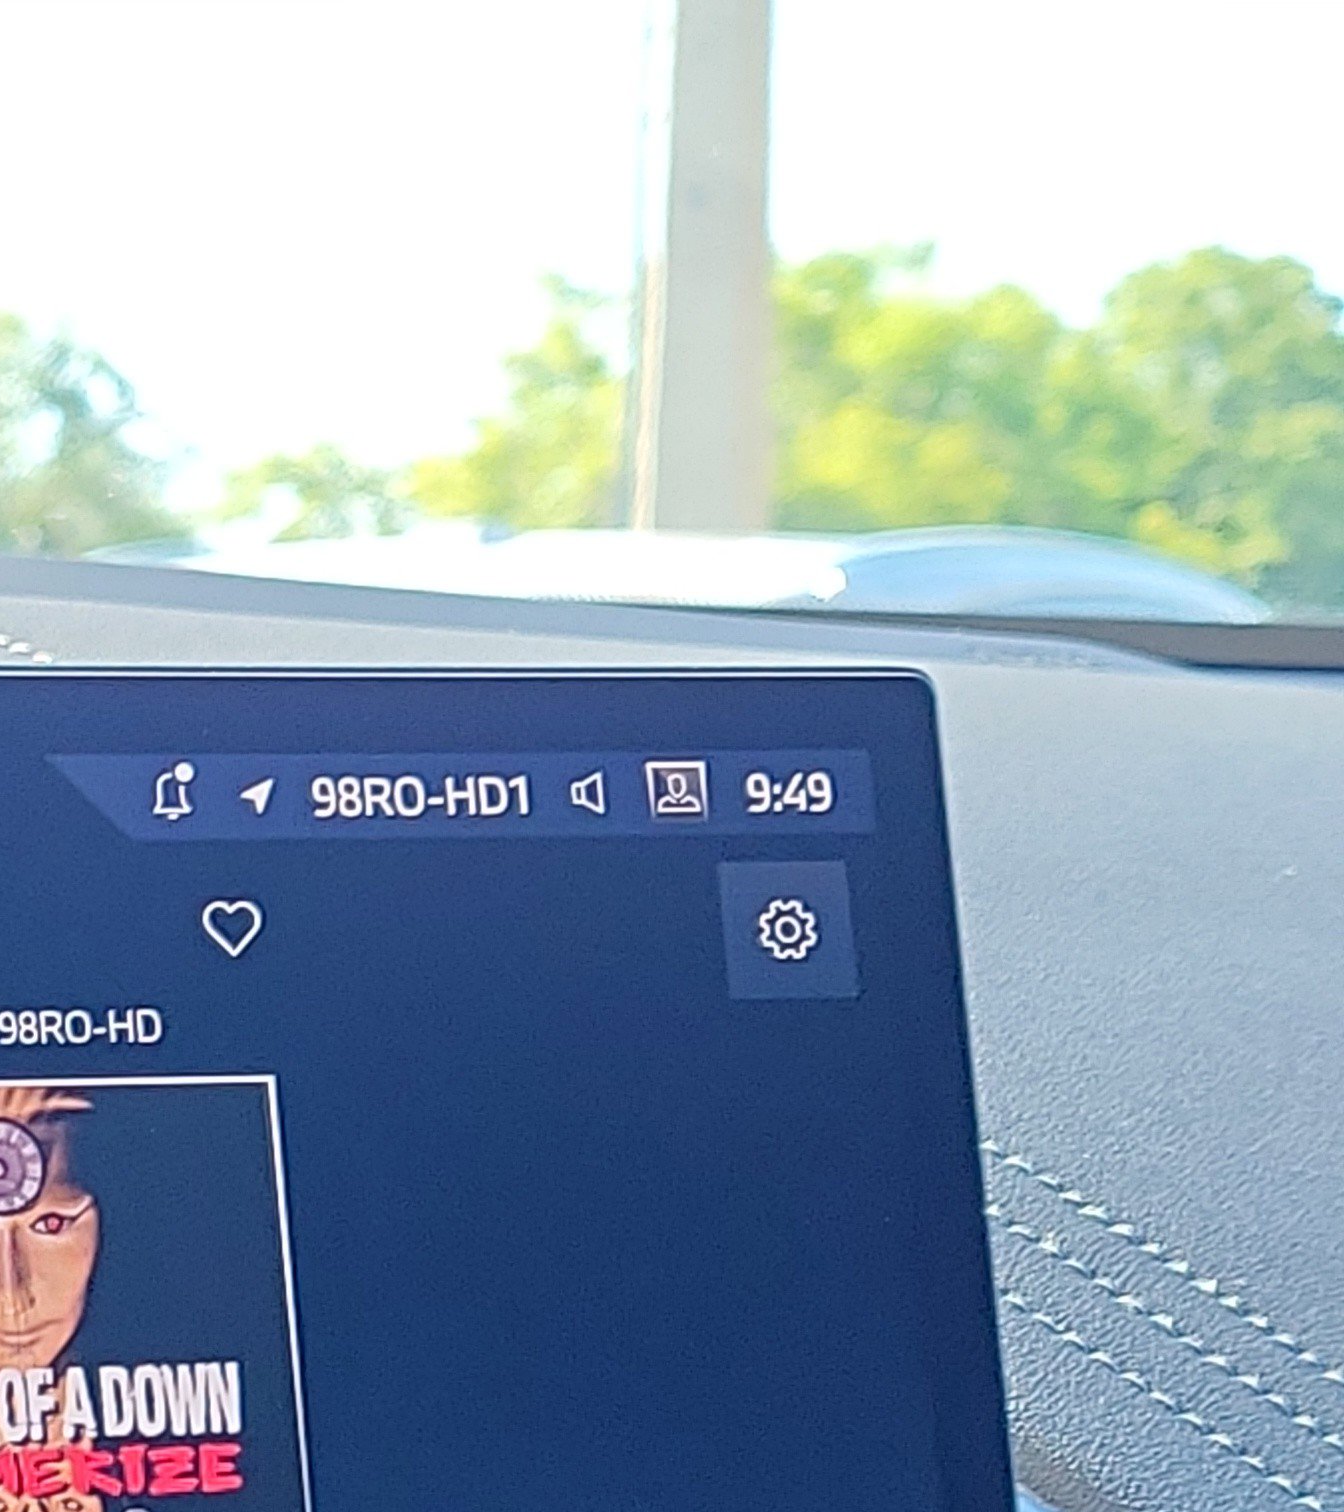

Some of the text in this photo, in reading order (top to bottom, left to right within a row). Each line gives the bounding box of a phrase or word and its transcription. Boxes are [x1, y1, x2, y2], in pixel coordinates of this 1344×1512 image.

[312, 775, 531, 818] 98RO-HD1
[745, 771, 835, 814] 9:49
[62, 1365, 98, 1438] A
[98, 1361, 242, 1438] DOWN
